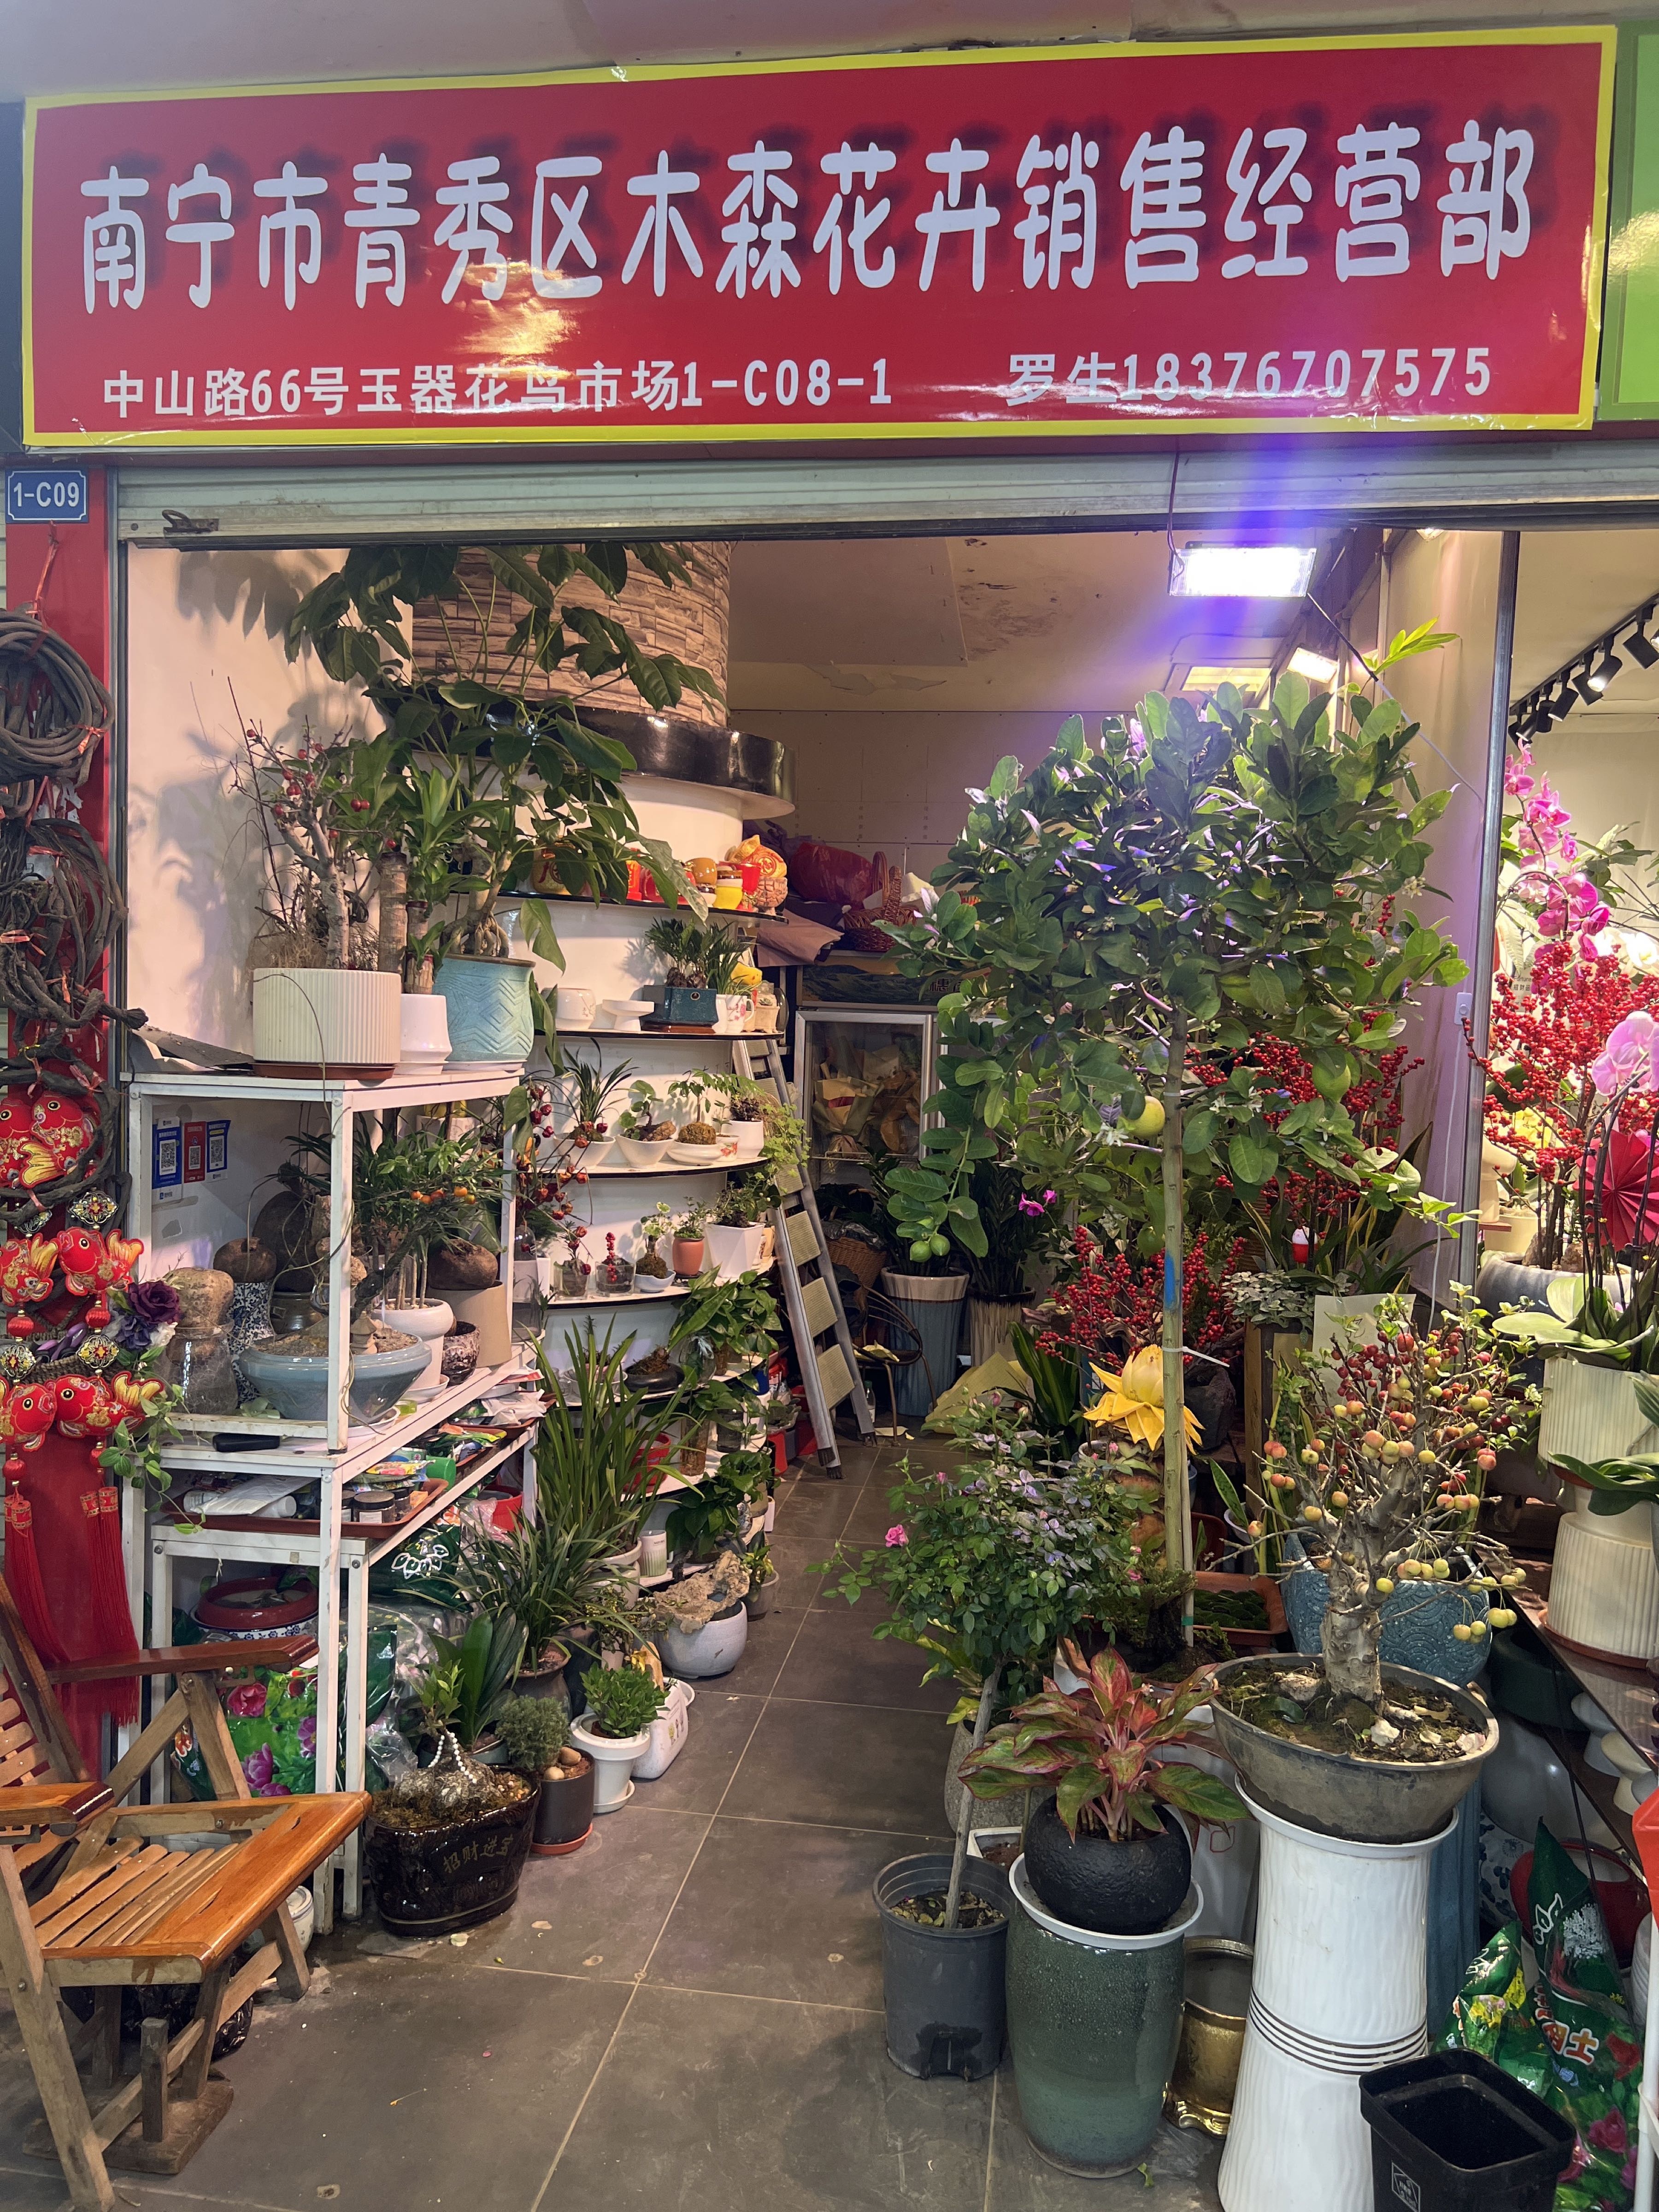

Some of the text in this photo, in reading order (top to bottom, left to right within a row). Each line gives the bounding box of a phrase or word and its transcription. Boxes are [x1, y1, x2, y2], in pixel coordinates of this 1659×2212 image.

[80, 119, 1534, 315] 南宁市青秀区木森花卉销售经营部
[104, 347, 1492, 418] 中山路66号玉器花鸟市场1-C08-1 罗生18376707575
[13, 482, 80, 507] 1-C09
[443, 1834, 514, 1874] 招财进宝
